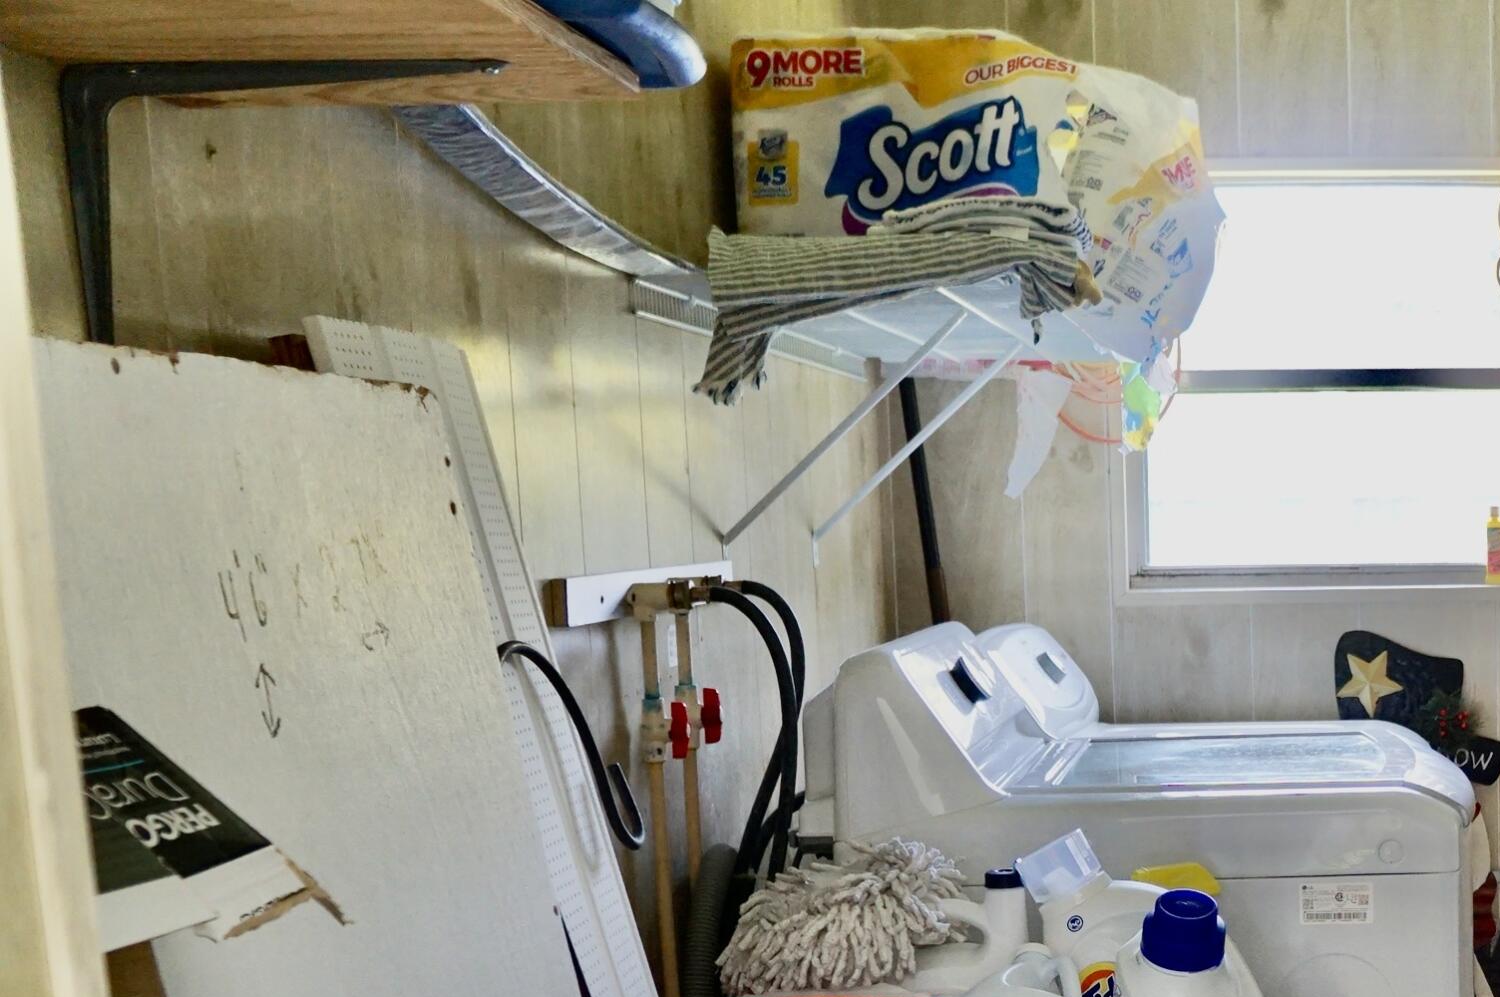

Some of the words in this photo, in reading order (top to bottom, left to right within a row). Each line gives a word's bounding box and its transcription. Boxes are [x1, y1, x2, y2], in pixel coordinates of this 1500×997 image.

[746, 50, 771, 88] 9
[772, 49, 863, 75] MORE
[772, 76, 814, 87] ROLLS
[965, 64, 1004, 84] OUR
[857, 100, 1020, 211] Scott
[755, 165, 787, 186] 45
[124, 803, 222, 848] PERGO
